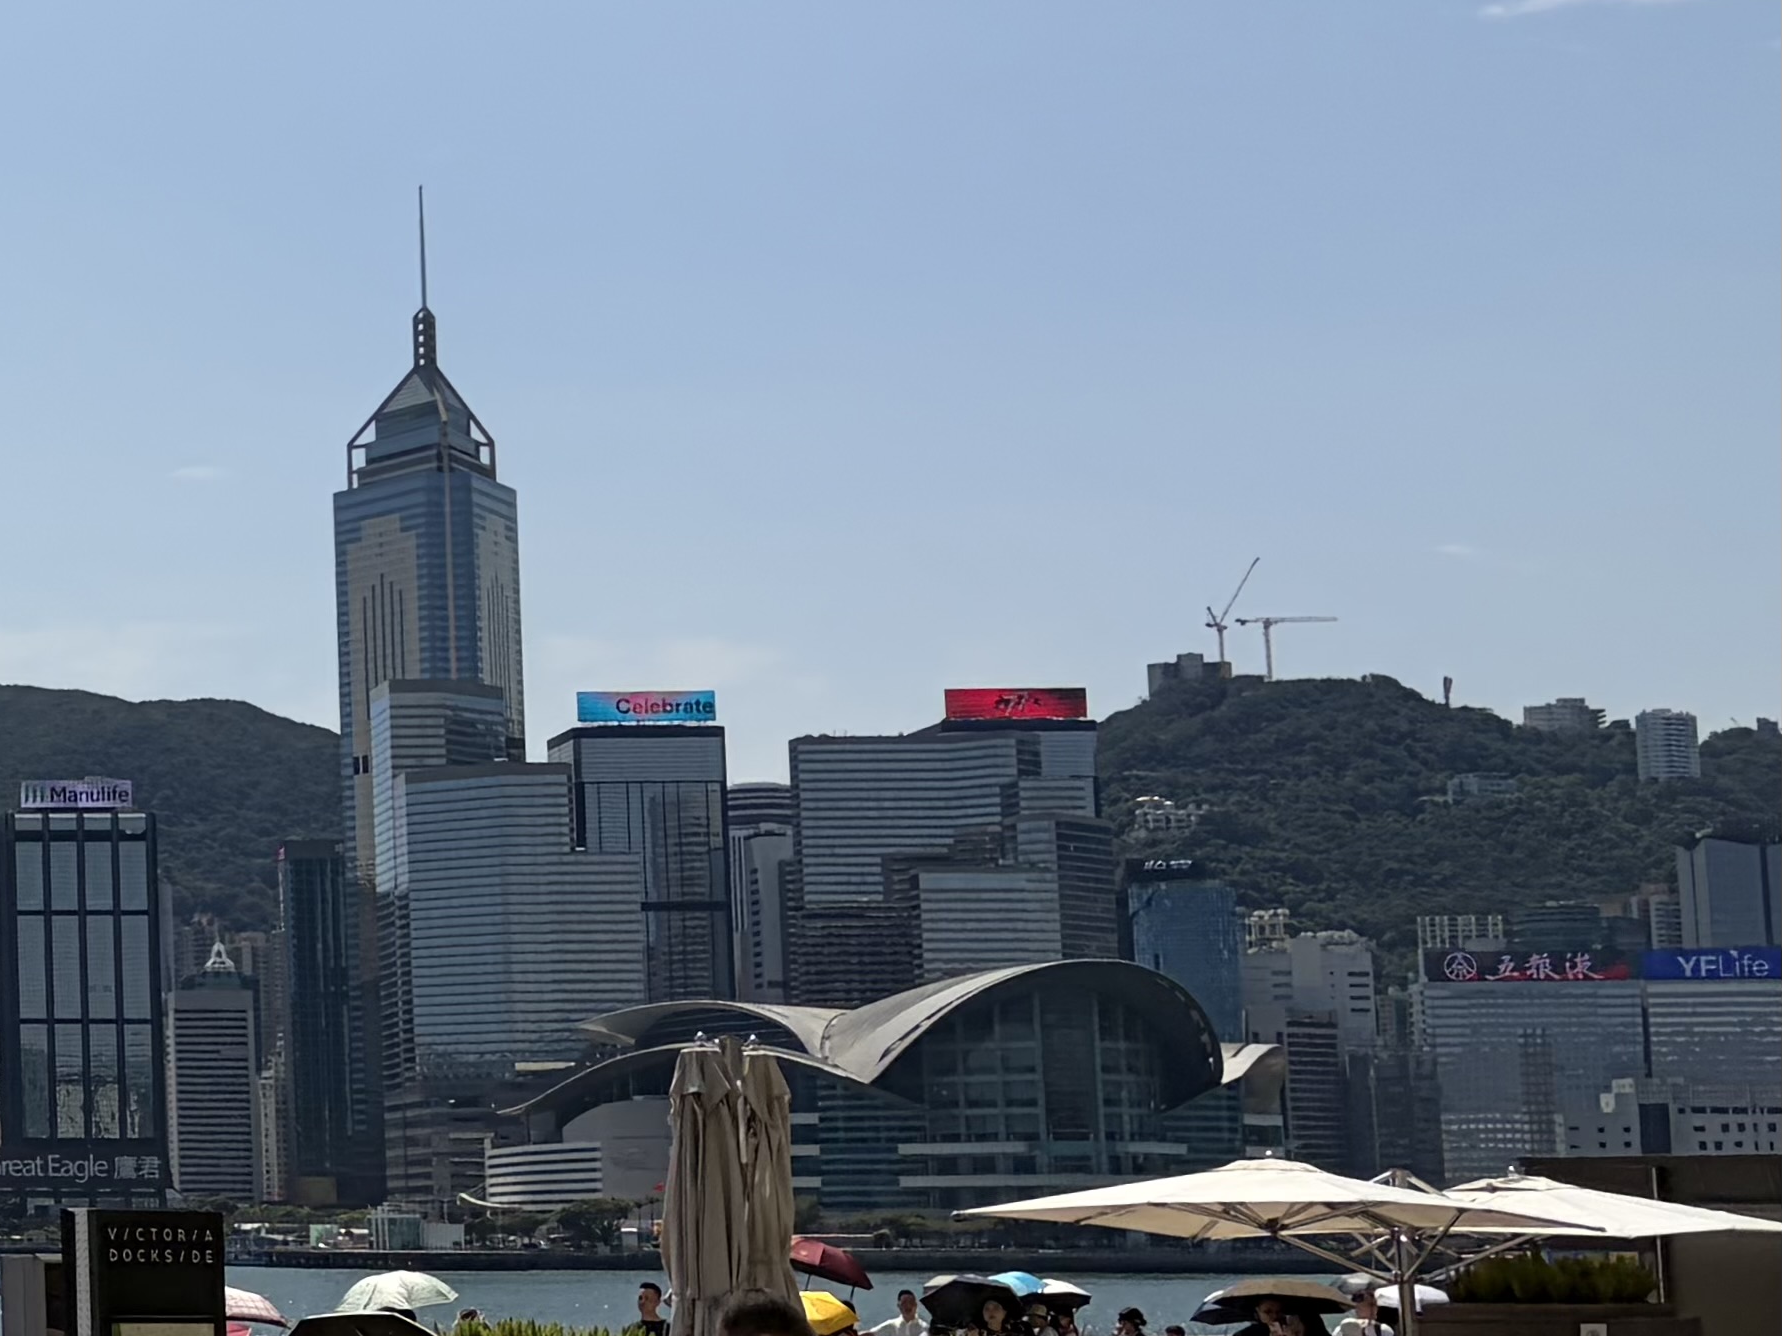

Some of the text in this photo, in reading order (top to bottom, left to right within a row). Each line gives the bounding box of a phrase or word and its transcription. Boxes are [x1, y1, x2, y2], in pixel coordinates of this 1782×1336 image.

[616, 697, 714, 715] Celebrate
[50, 786, 129, 803] Manulife
[48, 1154, 108, 1183] Eagle
[108, 1227, 213, 1242] VICTORIA
[109, 1248, 213, 1263] DOCKSIDE
